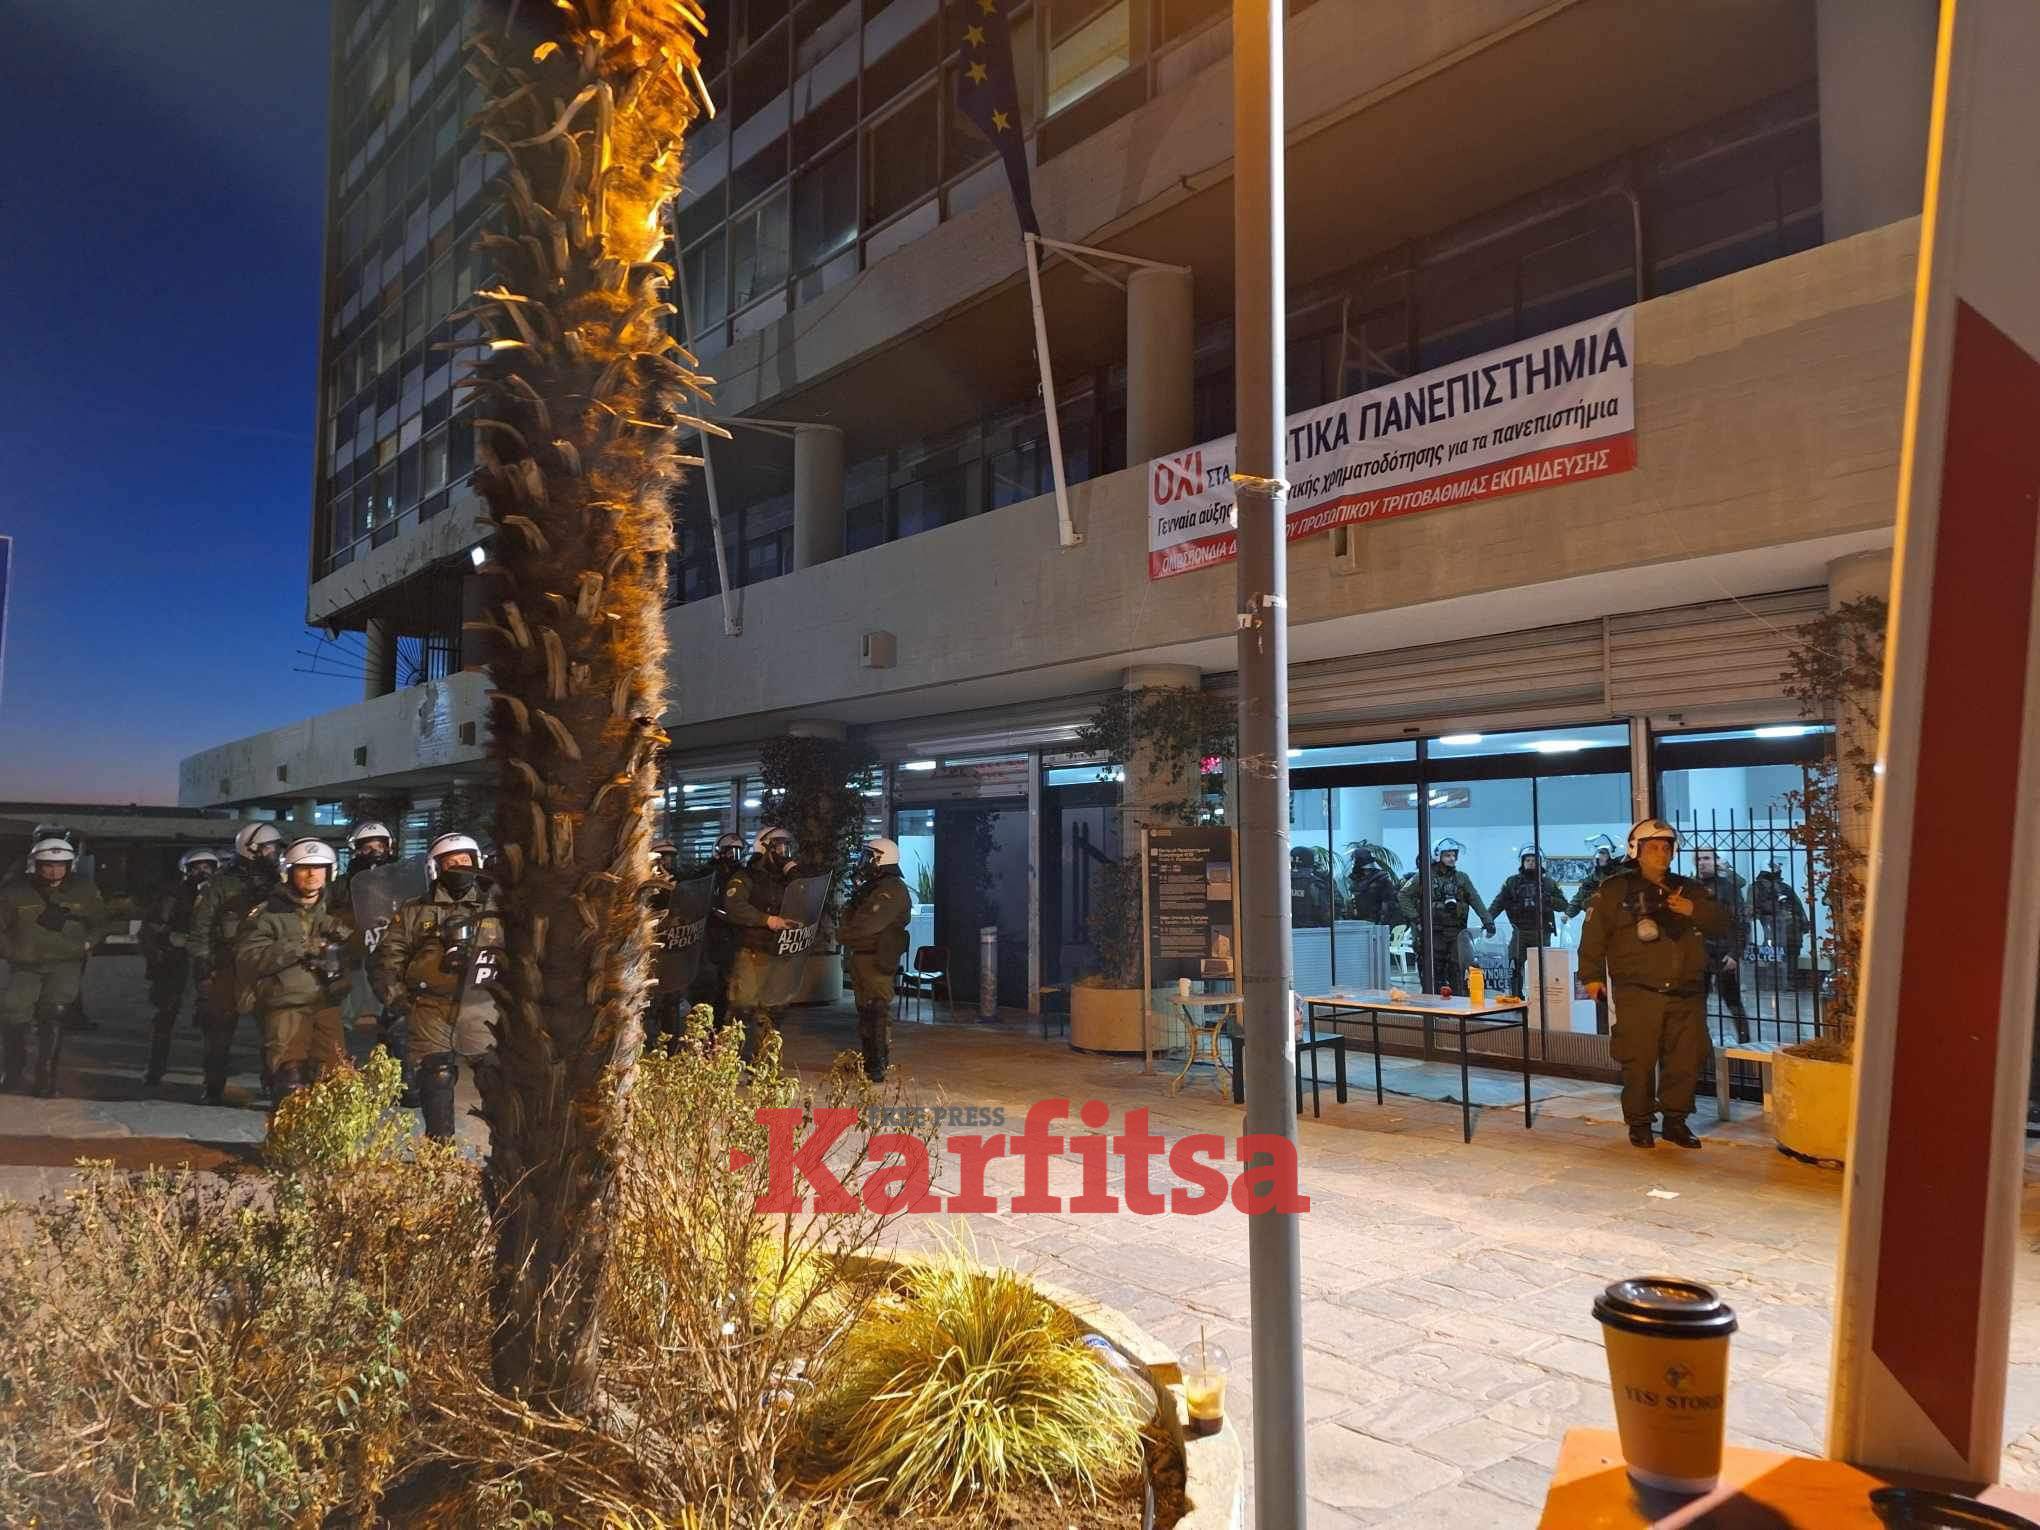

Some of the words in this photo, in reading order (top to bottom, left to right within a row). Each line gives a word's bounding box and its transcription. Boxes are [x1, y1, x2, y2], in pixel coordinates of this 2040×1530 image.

[1154, 450, 1205, 505] ΟΧΙ
[1206, 464, 1231, 489] ΣΤΑ
[1286, 412, 1350, 465] ΤΙΚΑ
[1358, 326, 1628, 442] ΠΑΝΕΠΙΣΤΗΜΙΑ
[1158, 505, 1197, 537] Γενναία
[1199, 502, 1233, 526] αύξησ
[1287, 474, 1321, 501] τικής
[1321, 443, 1445, 495] χρηματοδότησης
[1448, 440, 1468, 462] για
[1472, 434, 1488, 449] τα
[1492, 397, 1619, 446] πανεπιστήμια
[1298, 499, 1380, 535] ΠΡΟΣΩΠΙΚΟΥ
[1381, 474, 1490, 515] ΤΡΙΤΟΒΑΘΜΙΑΣ
[1491, 449, 1611, 490] ΕΚΠΑΙΔΕΥΣΗΣ
